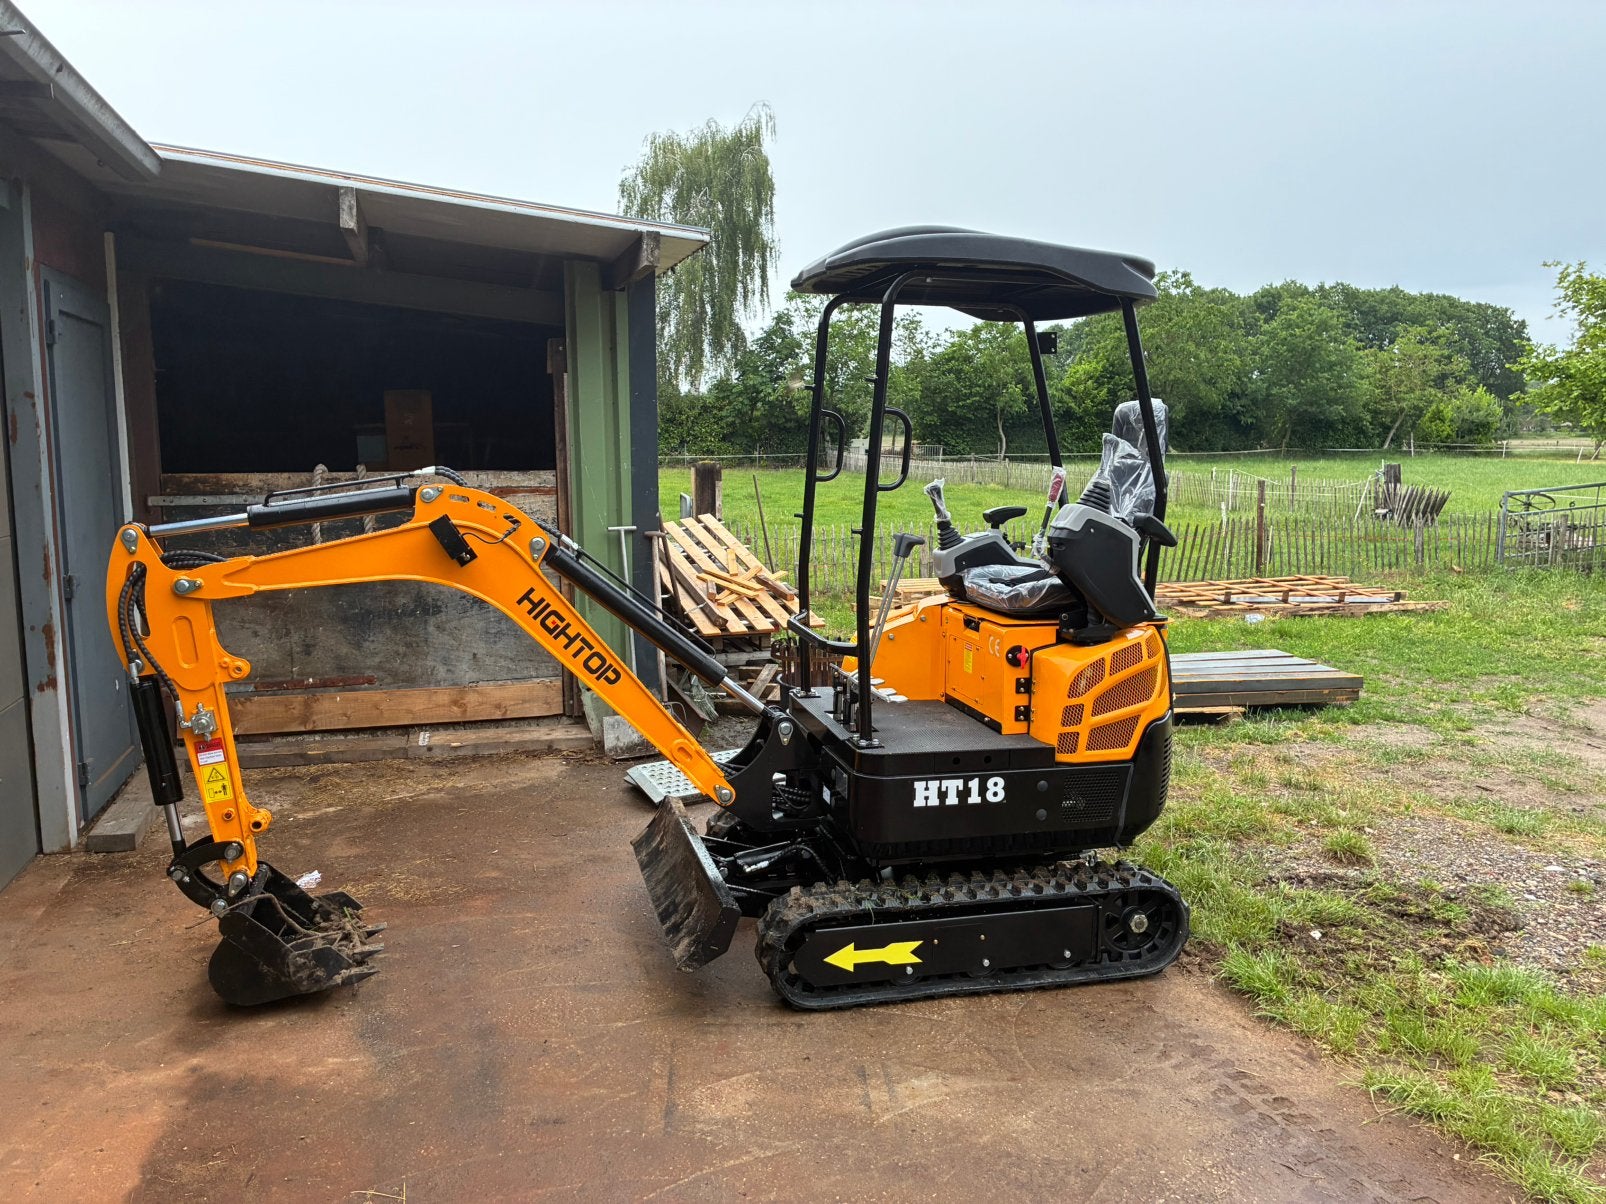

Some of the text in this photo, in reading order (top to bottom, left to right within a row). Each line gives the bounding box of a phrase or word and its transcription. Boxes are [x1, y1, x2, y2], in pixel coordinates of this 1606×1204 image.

[516, 587, 622, 685] HIGHTOP
[988, 636, 1001, 657] CE
[913, 776, 1006, 807] HT18
